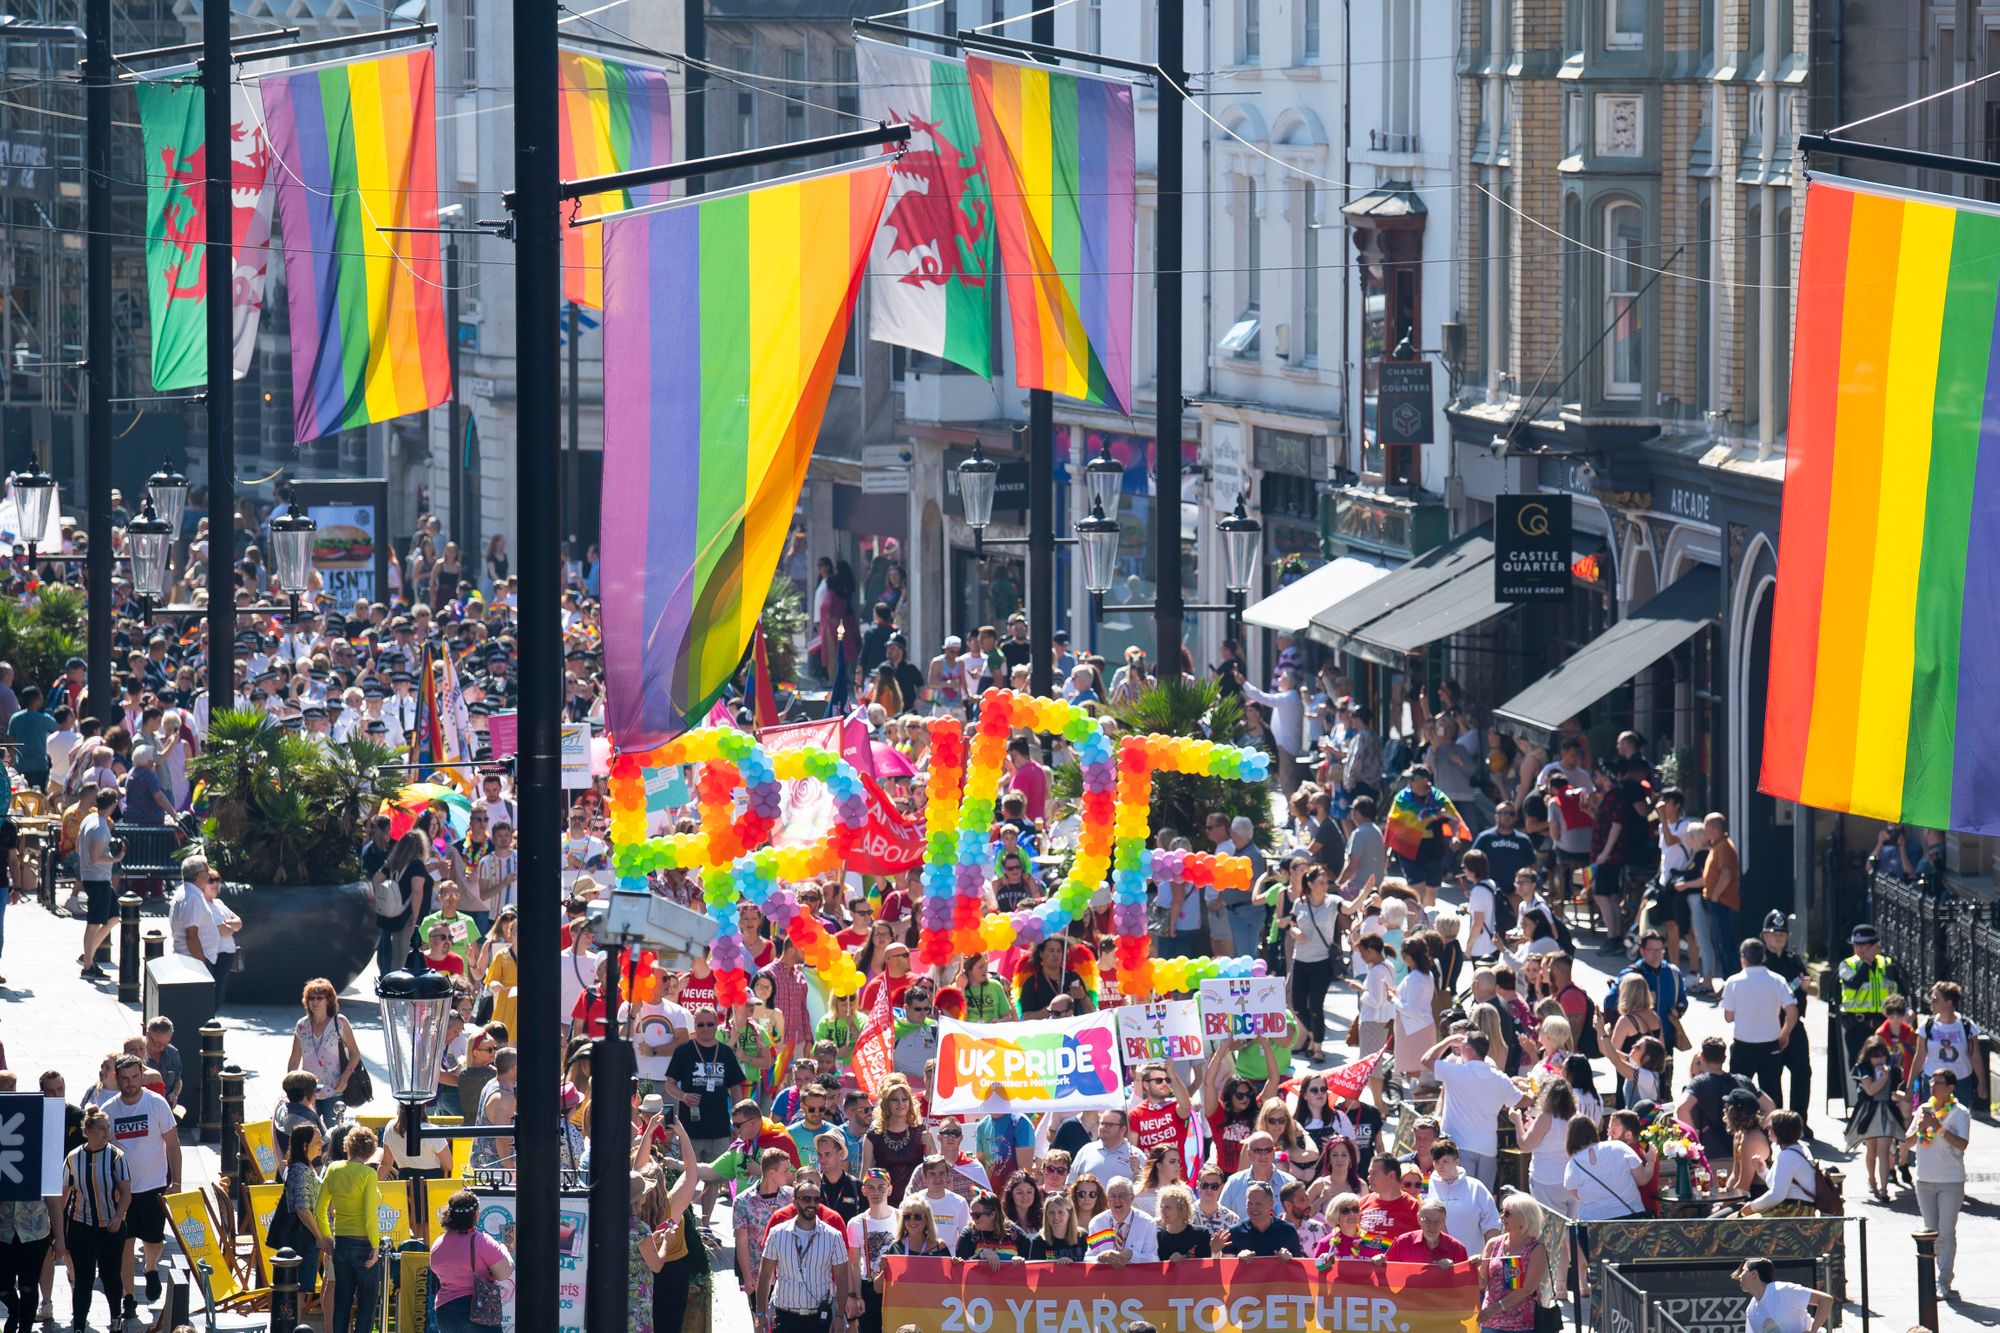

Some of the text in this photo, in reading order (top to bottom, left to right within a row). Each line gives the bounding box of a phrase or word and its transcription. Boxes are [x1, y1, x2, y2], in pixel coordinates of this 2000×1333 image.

[1387, 368, 1424, 376] CHANCE
[1403, 376, 1409, 384] &
[1382, 384, 1430, 392] COUNTERS
[1671, 488, 1710, 520] ARCADE
[1509, 550, 1559, 561] CASTLE
[1502, 561, 1566, 572] QUARTER
[1503, 586, 1565, 595] CASTLE ARCADE
[1491, 839, 1520, 849] adidas
[682, 988, 715, 999] NEVER
[1229, 980, 1251, 997] LU
[1145, 1004, 1167, 1021] LU
[1235, 996, 1249, 1013] 4
[1152, 1020, 1164, 1036] 4
[1204, 1012, 1286, 1035] BRIDGEND
[1125, 1034, 1201, 1059] BRIDGEND
[957, 1044, 1095, 1078] UK PRIDE
[979, 1075, 1070, 1088] Organisers Network
[1140, 1113, 1173, 1131] NEVER
[1140, 1126, 1177, 1146] KISSED
[177, 1221, 205, 1236] Havana
[941, 1296, 993, 1333] 20
[1168, 1294, 1410, 1333] TOGETHER.
[1666, 1297, 1747, 1322] PIZZ
